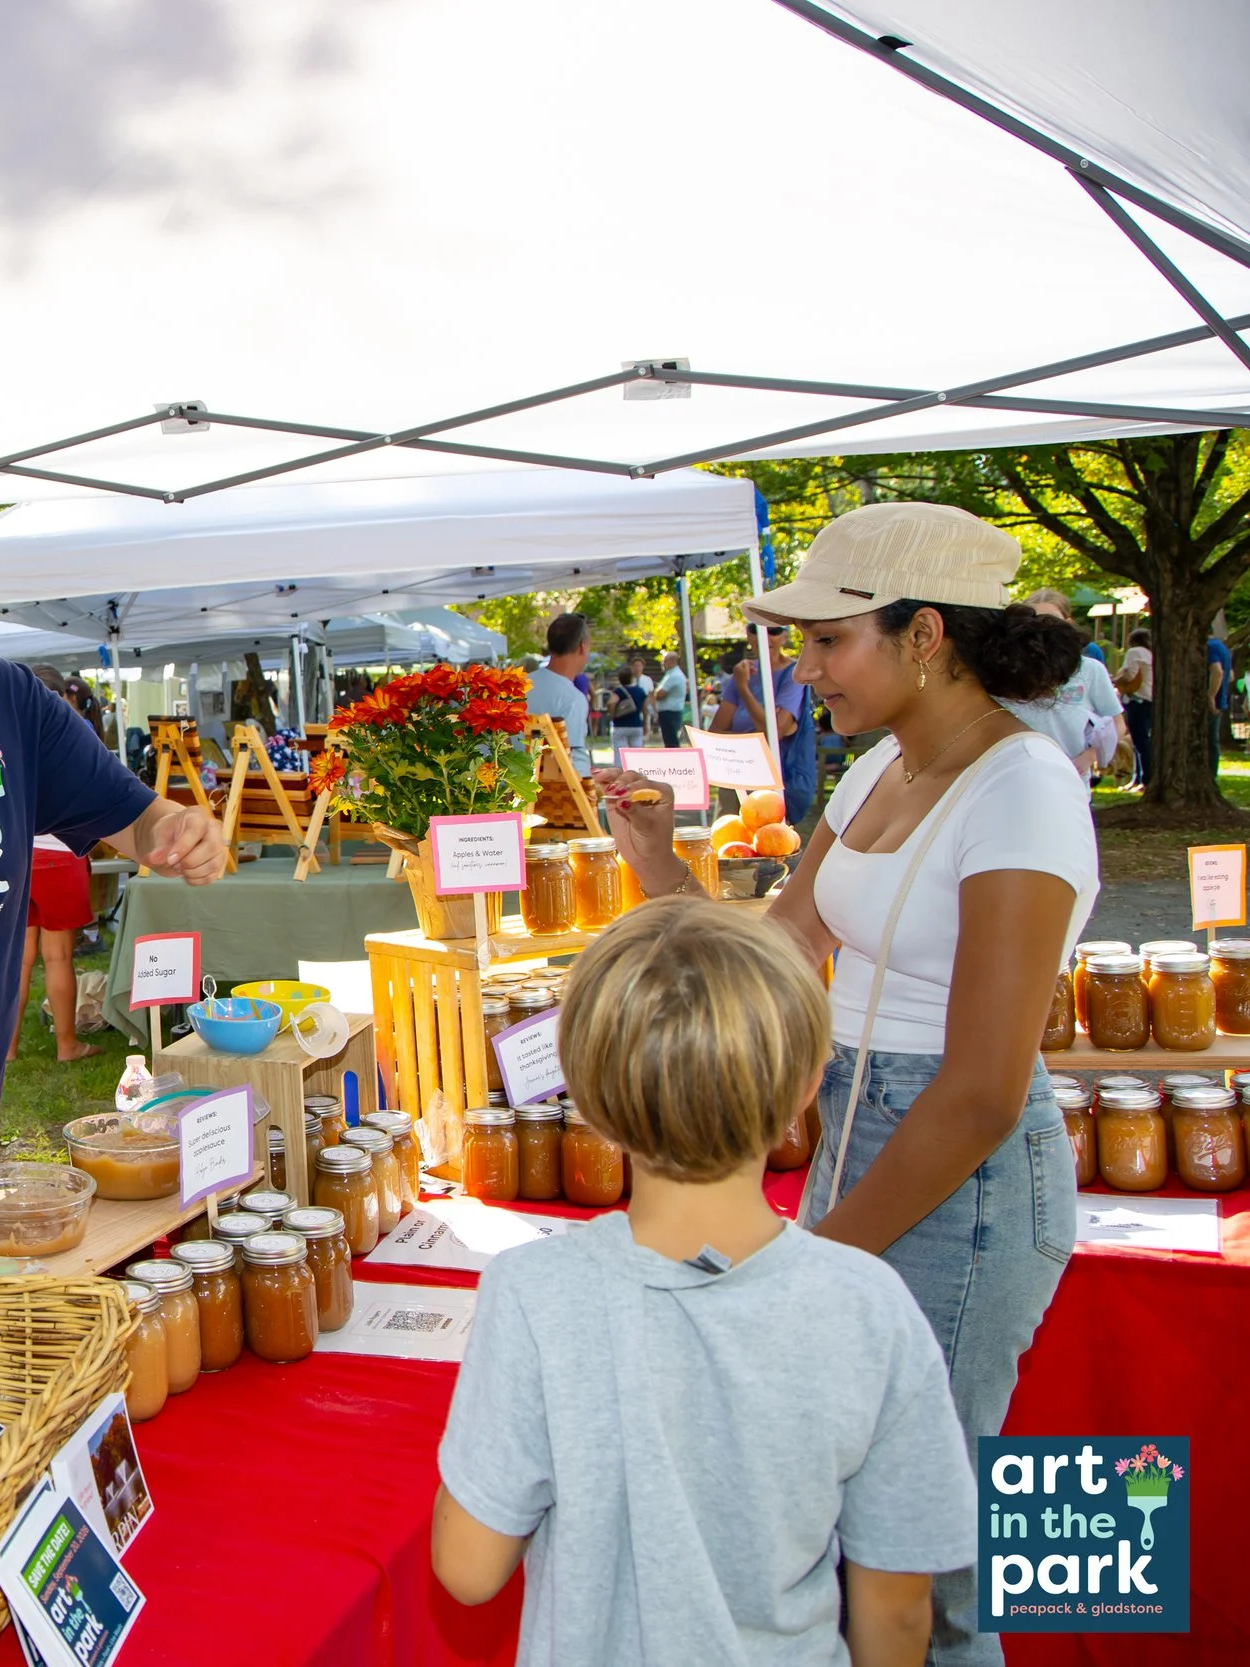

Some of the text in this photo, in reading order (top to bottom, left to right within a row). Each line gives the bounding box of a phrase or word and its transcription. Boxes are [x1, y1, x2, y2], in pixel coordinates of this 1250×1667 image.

[638, 767, 696, 777] Family Made!
[453, 851, 474, 860] Apples
[149, 955, 158, 963] No
[155, 968, 176, 978] Sugar
[520, 1031, 542, 1045] REVIEWS:
[522, 1046, 541, 1059] tasted
[542, 1041, 554, 1051] like
[196, 1111, 217, 1124] REVIEWS:
[188, 1123, 231, 1148] Super deliscious
[193, 1139, 225, 1157] applesauce
[395, 1227, 420, 1244] Plain
[28, 1522, 71, 1588] SAVE THE DATE!
[53, 1549, 74, 1582] September
[51, 1587, 73, 1624] art
[61, 1608, 84, 1642] in the
[74, 1612, 104, 1667] park
